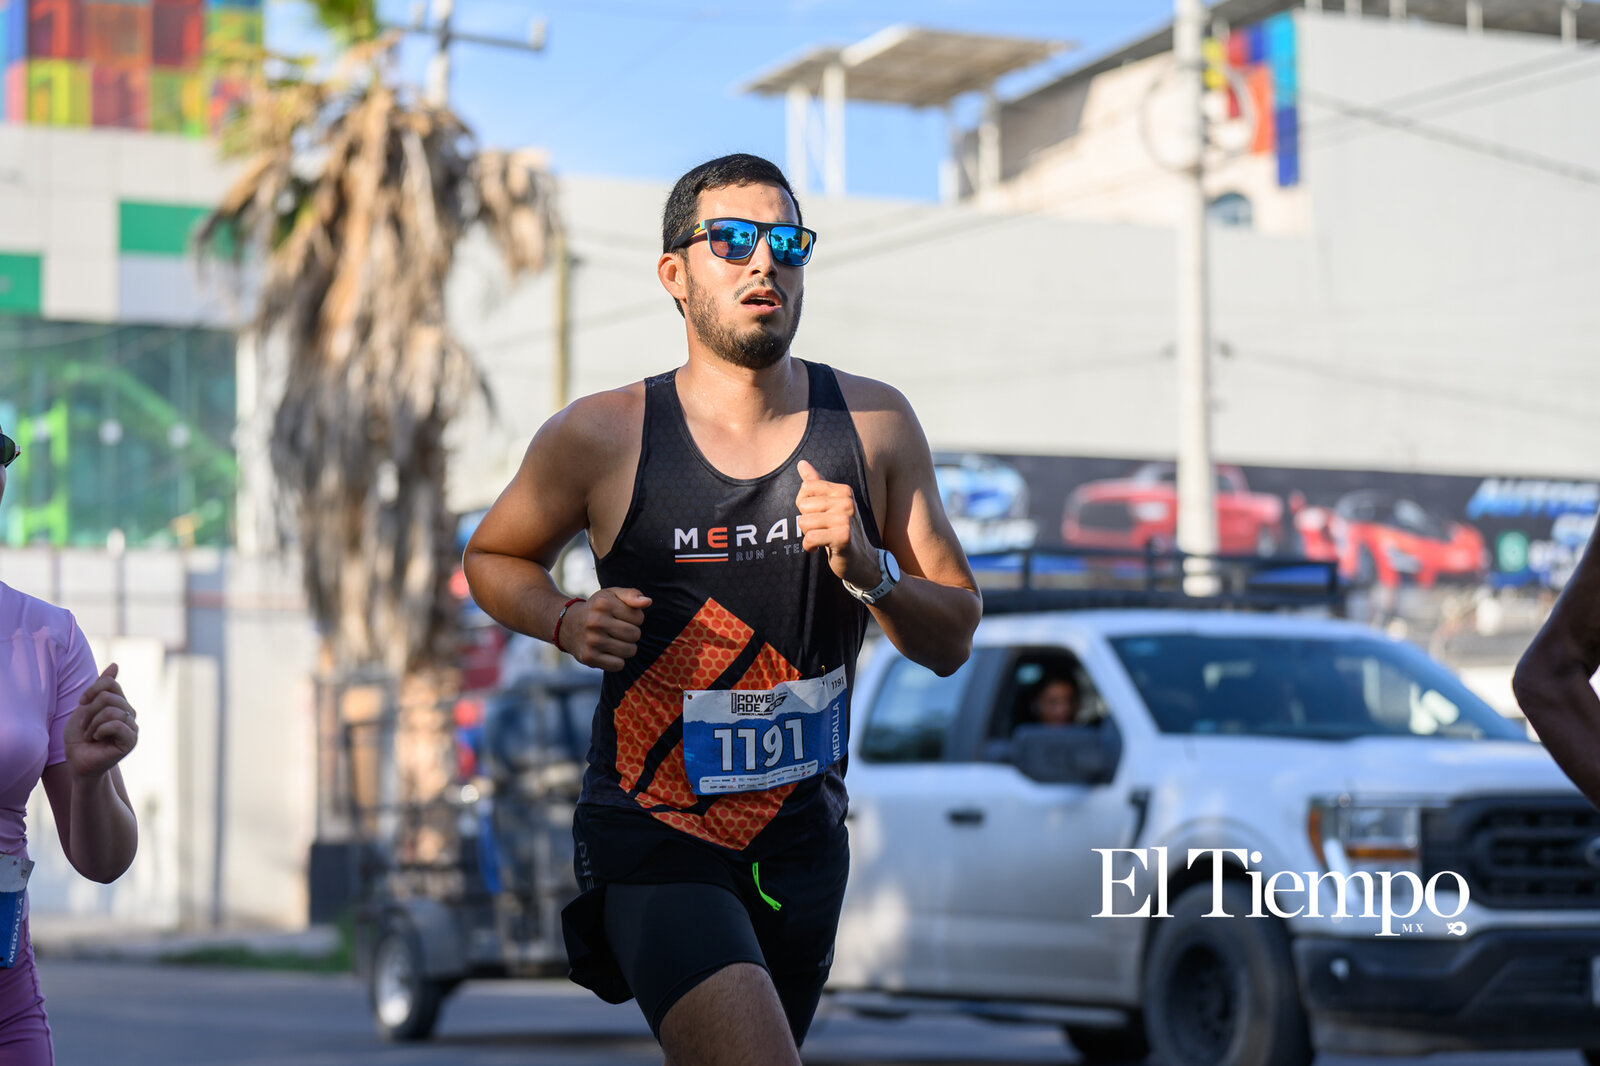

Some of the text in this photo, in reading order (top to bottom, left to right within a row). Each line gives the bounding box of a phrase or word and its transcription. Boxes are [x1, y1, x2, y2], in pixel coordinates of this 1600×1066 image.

[736, 549, 765, 562] RUN
[831, 677, 844, 691] 1191
[714, 718, 804, 772] 1191
[832, 701, 841, 761] MEDALLA
[9, 897, 24, 963] MEDALLA
